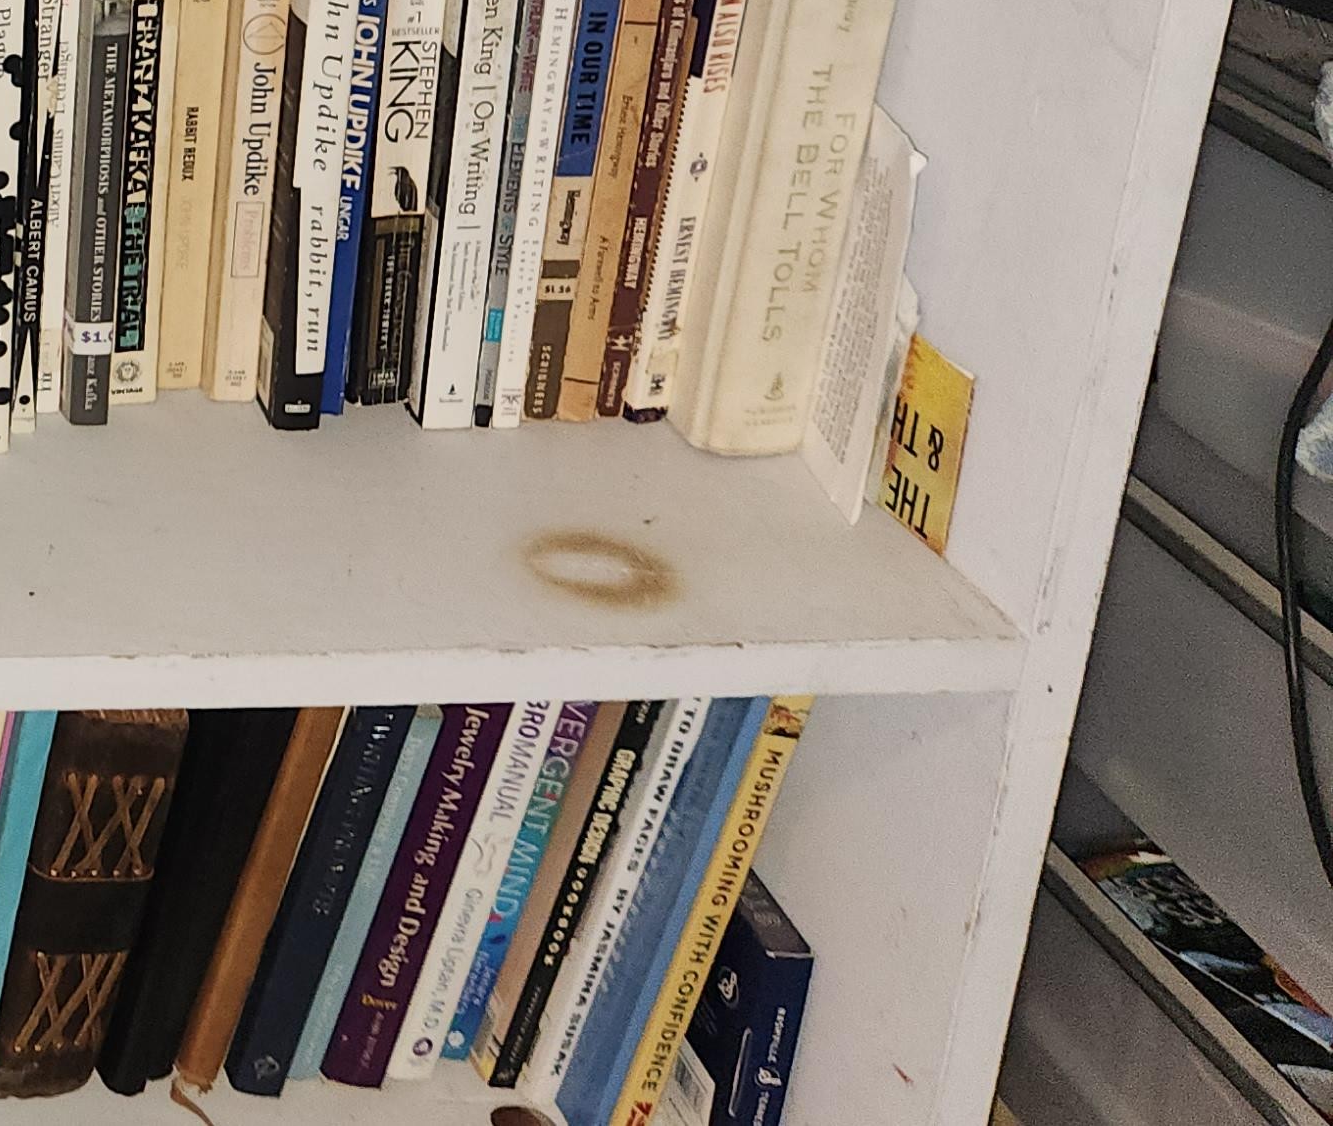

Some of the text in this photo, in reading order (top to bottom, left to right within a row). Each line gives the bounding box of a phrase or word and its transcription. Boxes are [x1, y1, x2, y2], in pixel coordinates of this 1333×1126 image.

[384, 41, 421, 143] KING
[414, 41, 438, 139] STEPHEN
[474, 26, 503, 75] King
[570, 11, 608, 144] IN OUR TIME
[471, 100, 495, 135] On
[458, 141, 491, 216] Writing
[304, 205, 324, 353] rabbit, run
[884, 470, 930, 541] THE
[377, 706, 490, 990] Jewelry Making and Design
[711, 750, 782, 907] MUSHROOMING
[691, 910, 720, 965] WITH
[640, 971, 699, 1095] CONFIDENCE
